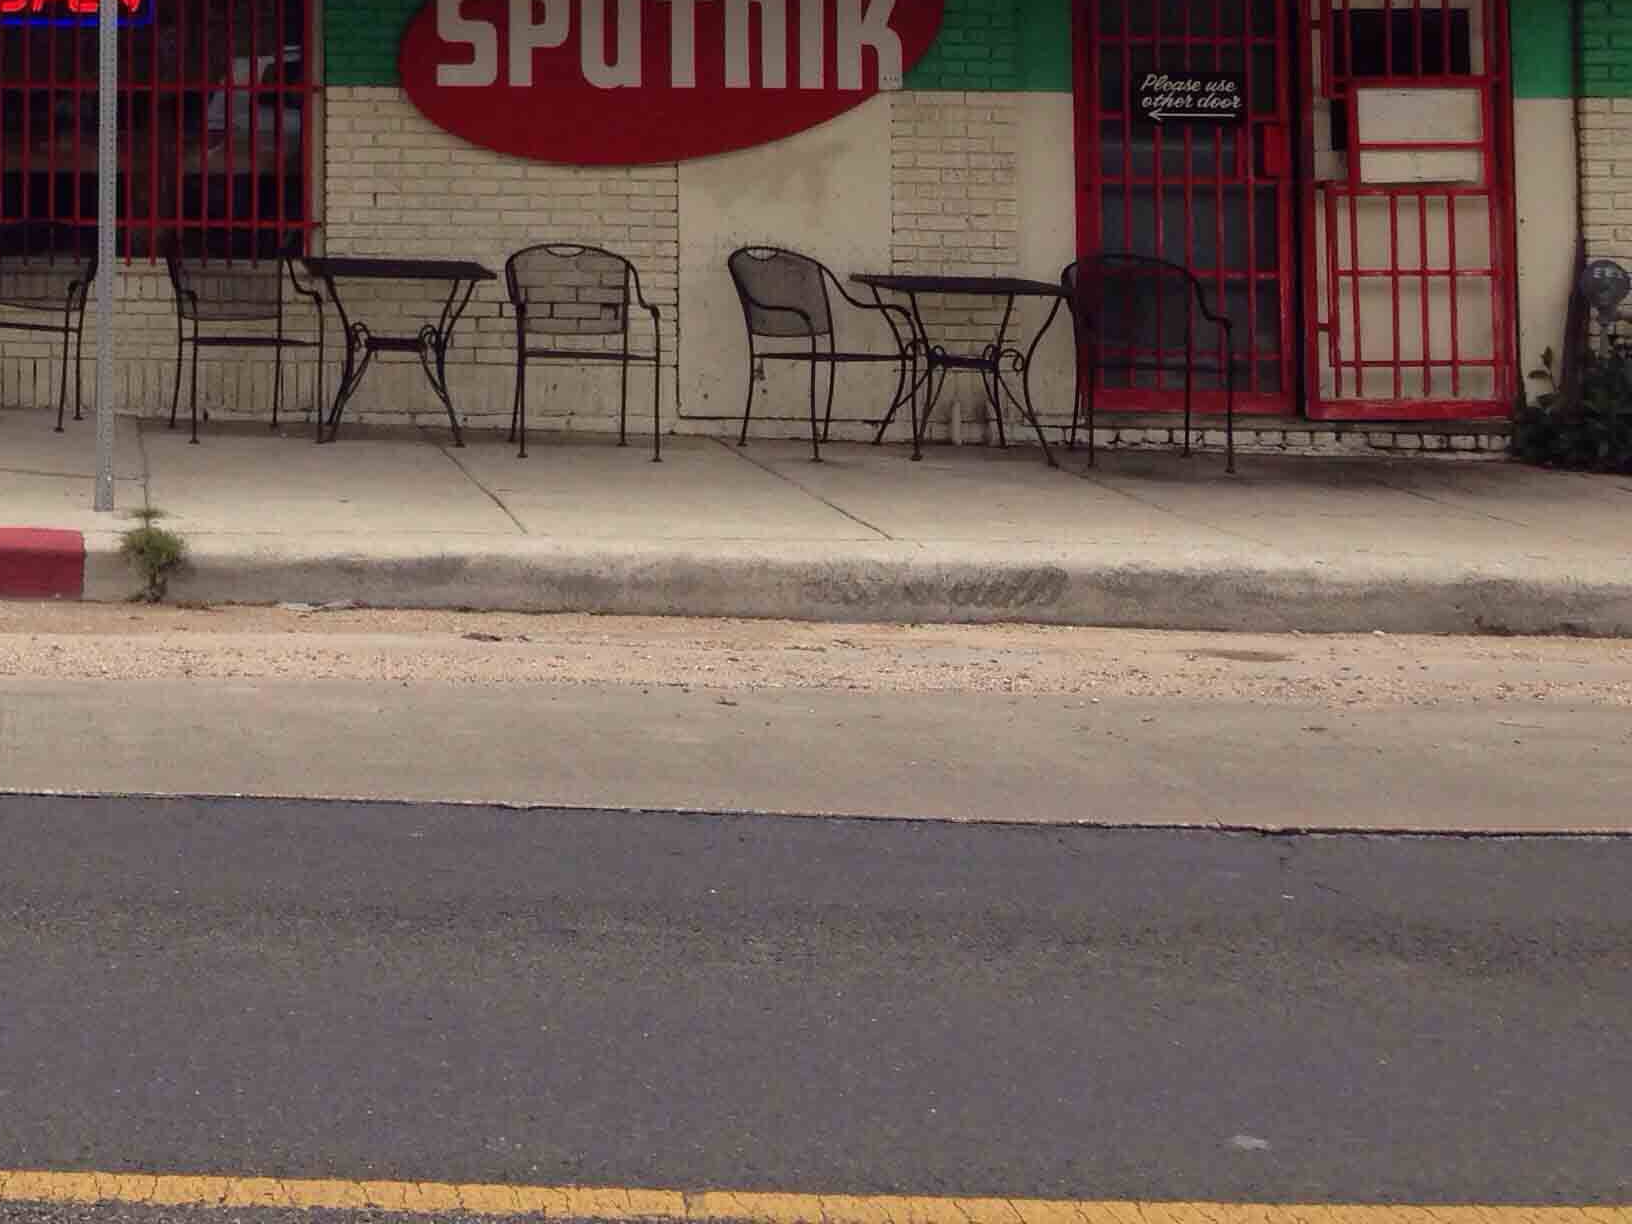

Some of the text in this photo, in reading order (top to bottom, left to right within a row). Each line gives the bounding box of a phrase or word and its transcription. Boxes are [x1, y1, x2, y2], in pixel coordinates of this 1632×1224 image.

[1139, 73, 1238, 93] Please use
[1141, 92, 1242, 109] other door
